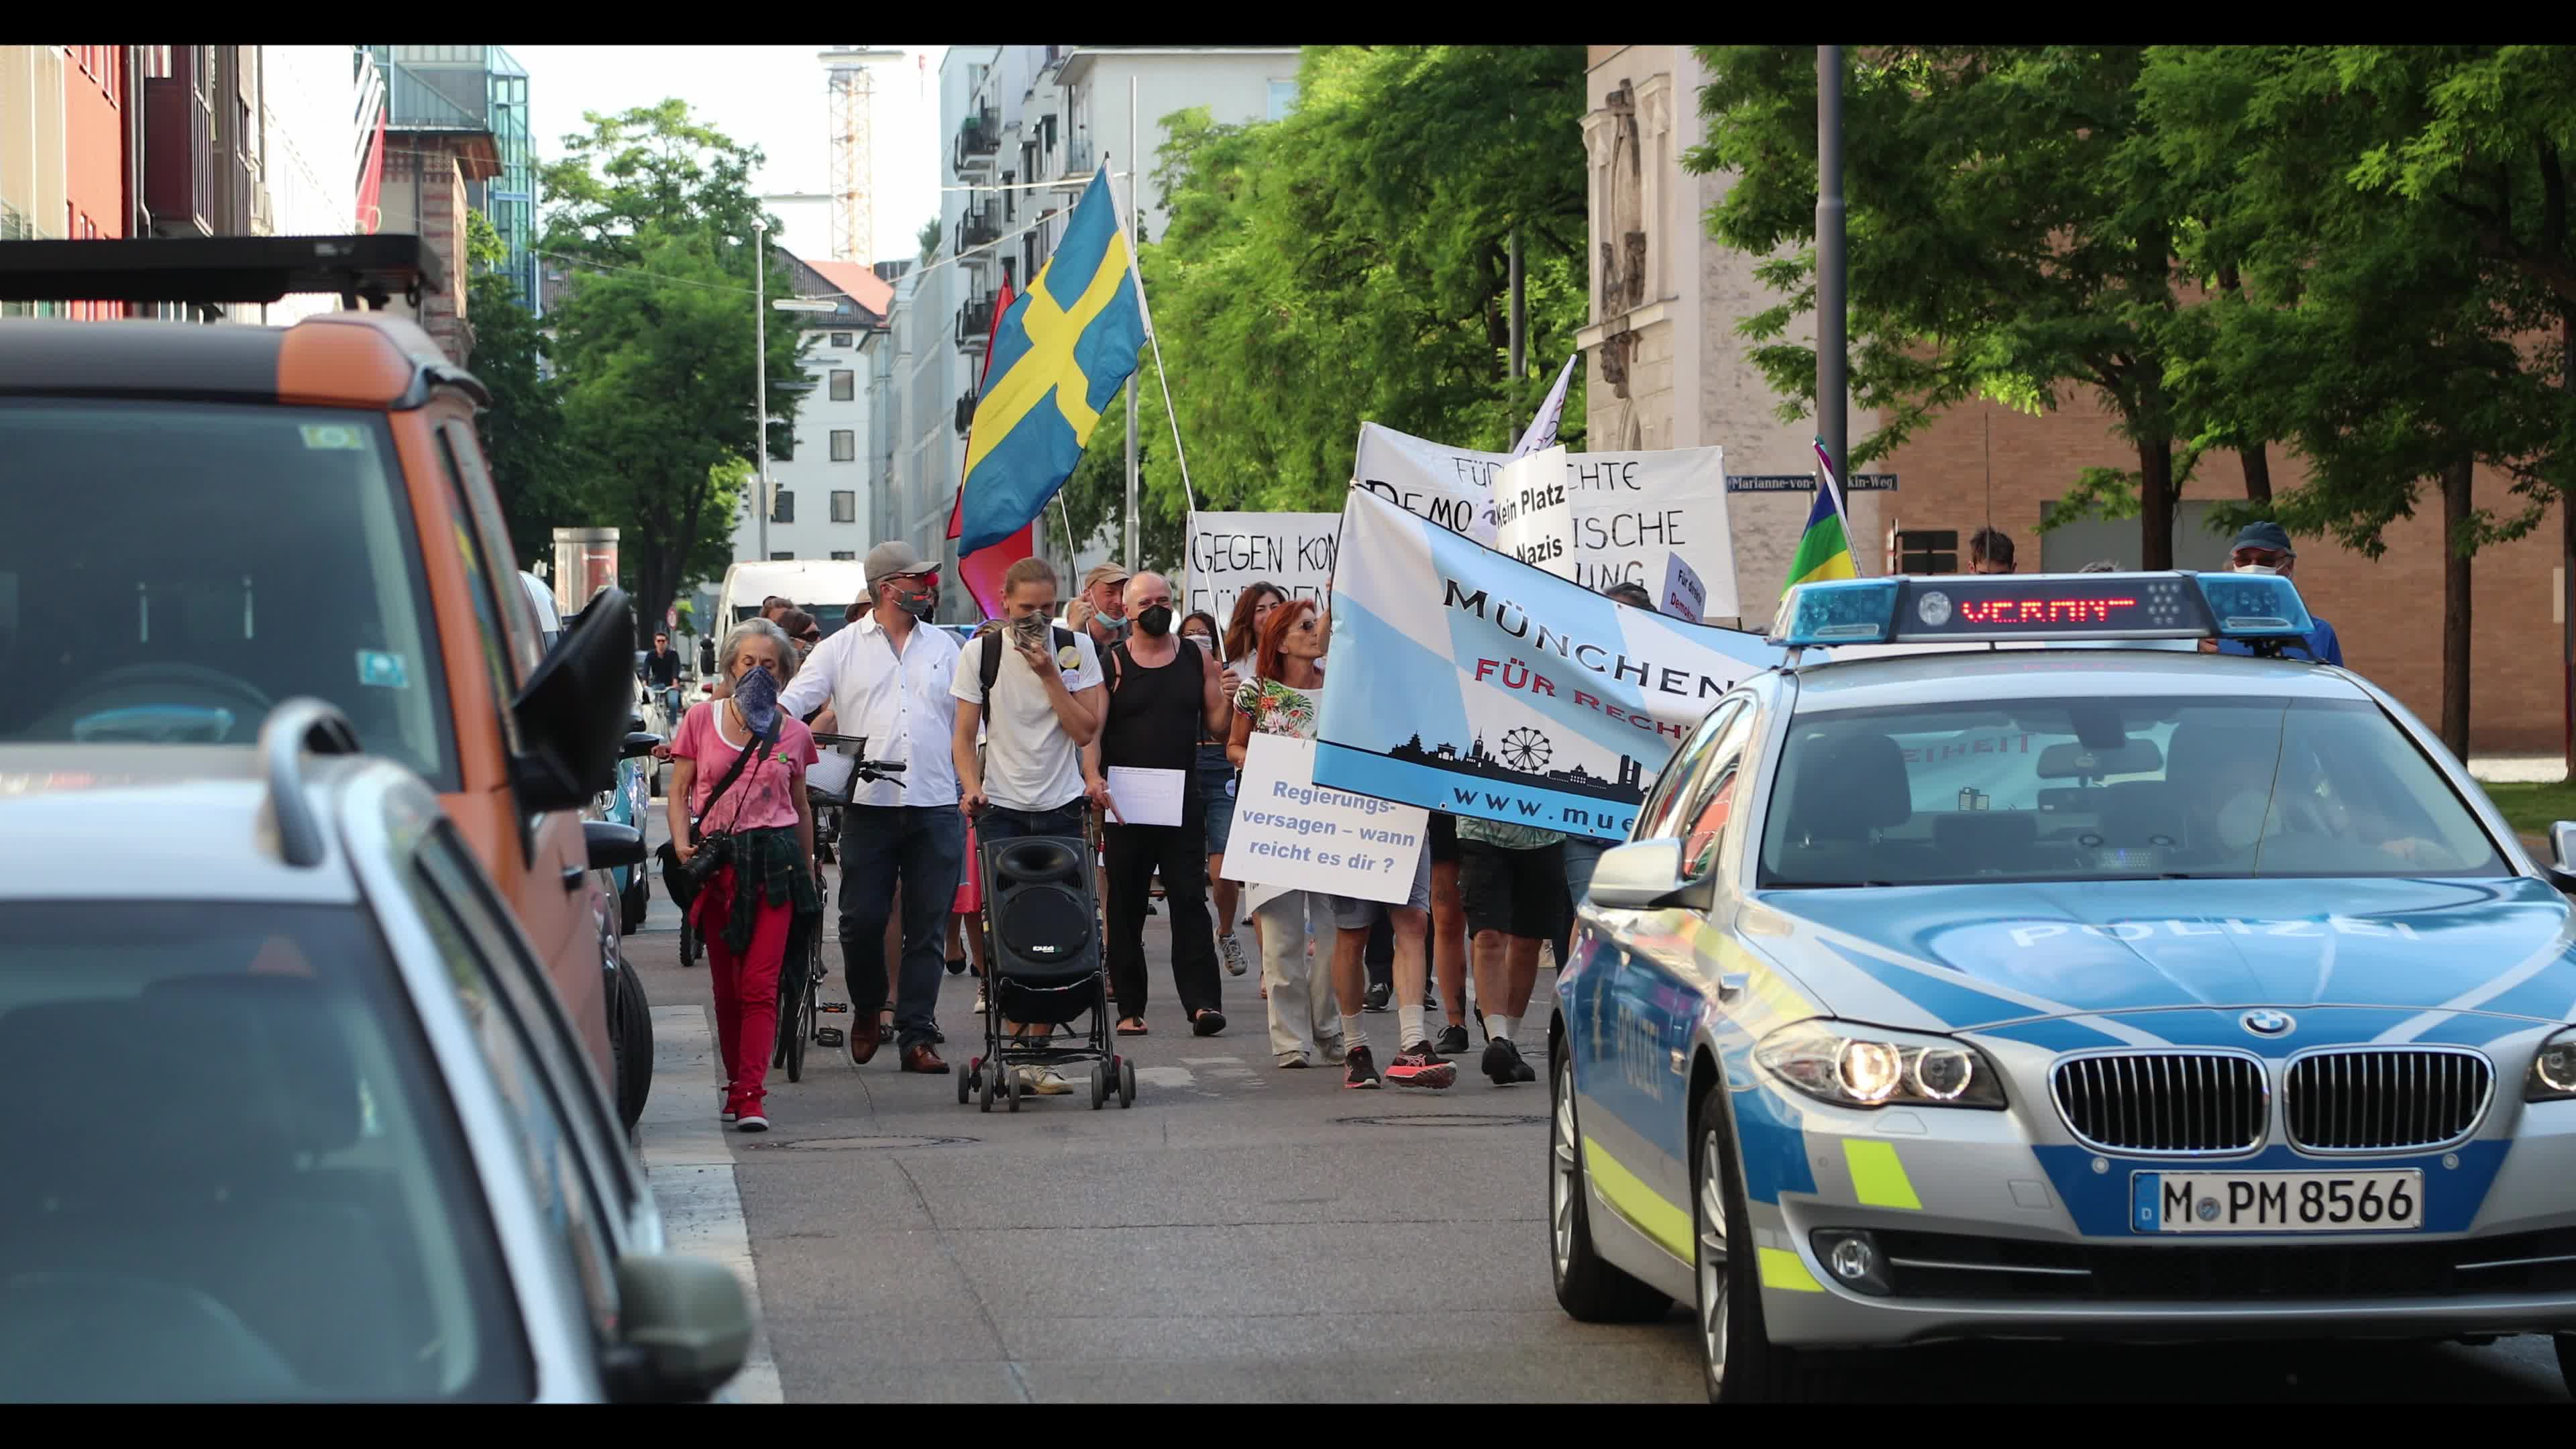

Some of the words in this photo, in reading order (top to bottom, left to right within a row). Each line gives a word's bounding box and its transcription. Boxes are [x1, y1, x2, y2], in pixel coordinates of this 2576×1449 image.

[1566, 461, 1642, 490] CHTE
[1731, 476, 1894, 491] Marianne-von-kin-Weg
[1496, 498, 1517, 530] Kein
[1521, 482, 1565, 515] Platz
[1192, 532, 1283, 574] GEGEN
[1516, 535, 1563, 565] Nazis
[1443, 578, 1734, 698] MÜNCHEN
[1474, 657, 1556, 698] FÜR
[1574, 688, 1692, 741] RECH
[1273, 780, 1397, 816] Regierungs-
[1242, 809, 1337, 835] versagen
[1359, 826, 1416, 847] wann
[1249, 841, 1311, 862] reicht
[1317, 851, 1342, 866] es
[1347, 853, 1377, 871] dir
[1383, 857, 1395, 874] ?
[2008, 916, 2422, 947] POLIZEI
[2141, 1208, 2152, 1220] D
[2163, 1180, 2193, 1223] M
[2228, 1180, 2288, 1224] PM
[2298, 1178, 2414, 1224] 8566
